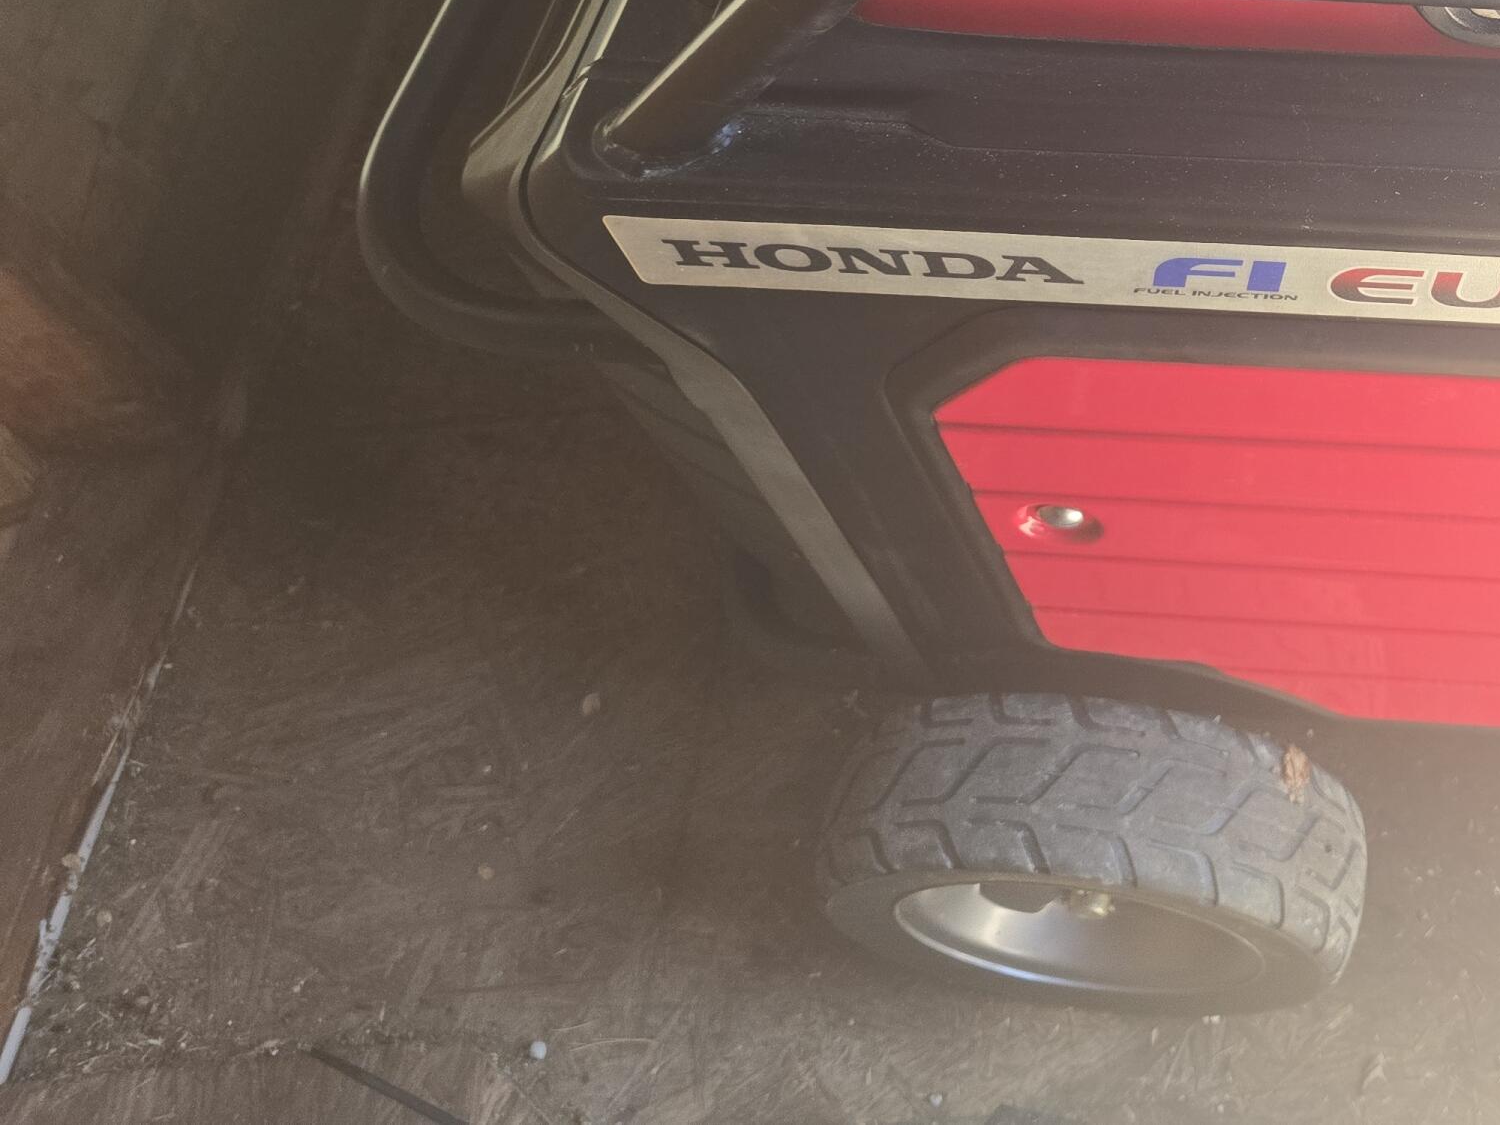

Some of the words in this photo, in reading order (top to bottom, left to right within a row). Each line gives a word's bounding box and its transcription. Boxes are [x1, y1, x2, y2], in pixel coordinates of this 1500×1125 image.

[661, 238, 1084, 285] HONDA
[1152, 257, 1289, 293] FI
[1133, 287, 1188, 297] FUEL
[1191, 289, 1298, 302] INJECTION
